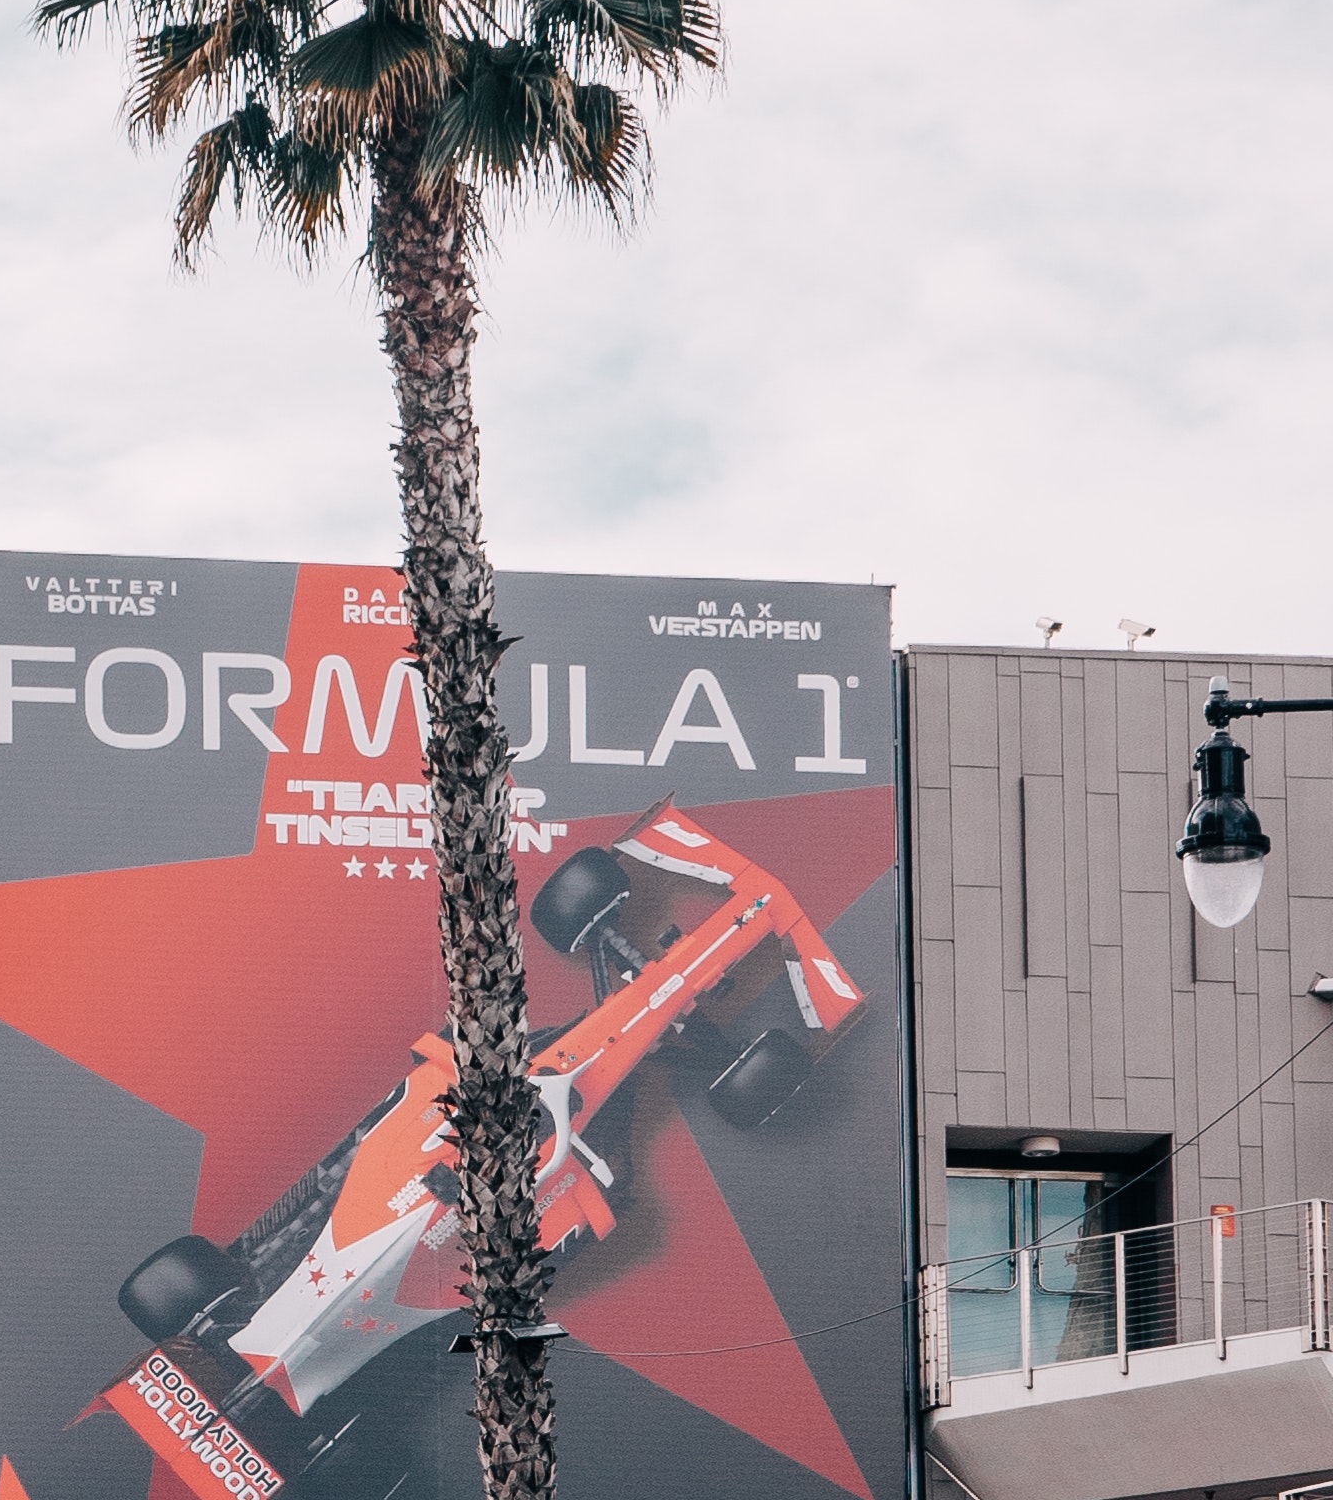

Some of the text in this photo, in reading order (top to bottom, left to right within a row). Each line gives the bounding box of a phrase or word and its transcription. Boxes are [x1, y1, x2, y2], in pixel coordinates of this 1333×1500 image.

[25, 575, 179, 596] VALTTERI
[47, 594, 157, 617] BOTTAS
[697, 600, 773, 619] MAX
[648, 615, 822, 642] VERSTAPPEN
[795, 673, 867, 775] 1
[148, 1355, 279, 1497] HOLLYWOOD
